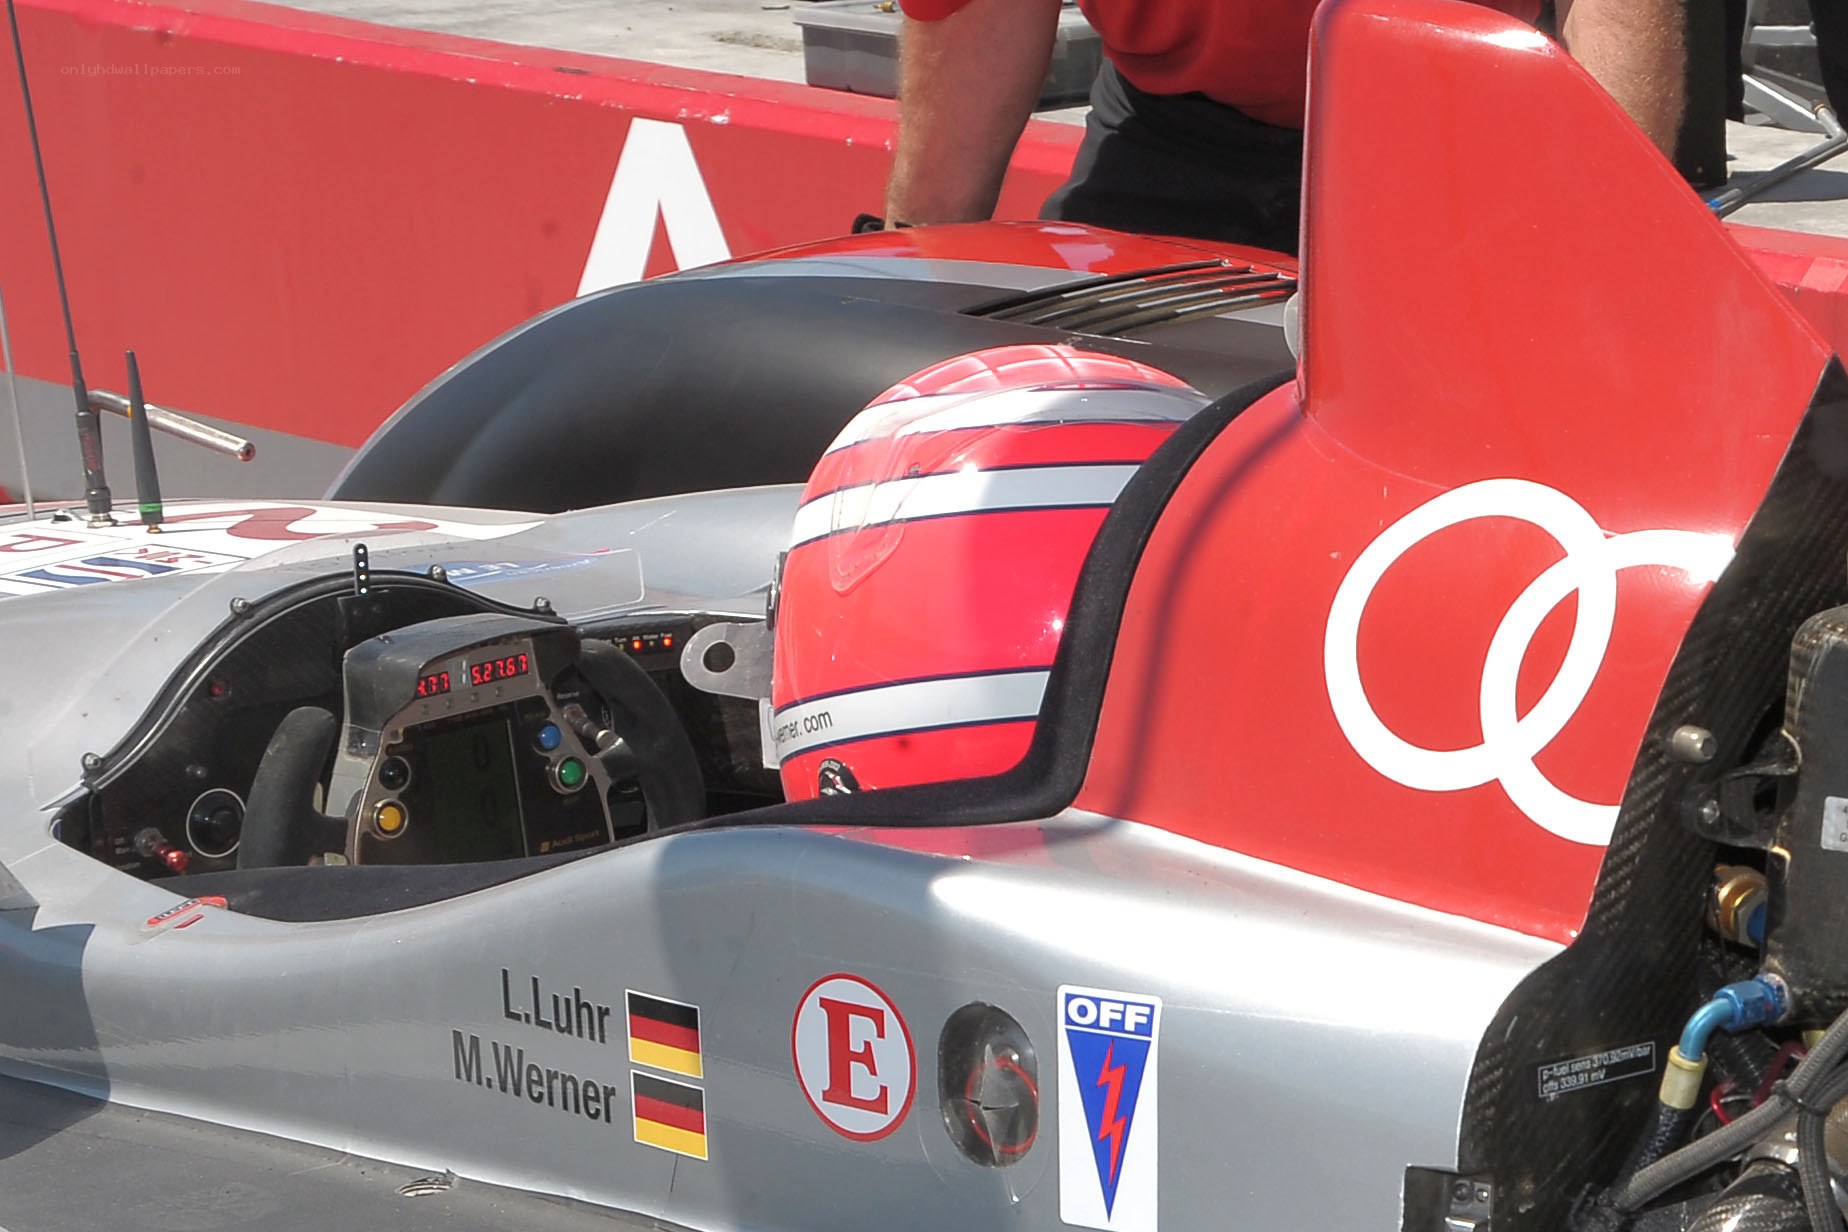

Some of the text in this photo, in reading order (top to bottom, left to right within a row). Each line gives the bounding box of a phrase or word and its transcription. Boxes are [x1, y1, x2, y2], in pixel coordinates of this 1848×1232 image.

[502, 968, 611, 1045] L.Luhr
[1067, 994, 1150, 1033] OFF
[453, 1028, 616, 1124] M.Werner
[819, 996, 888, 1116] E
